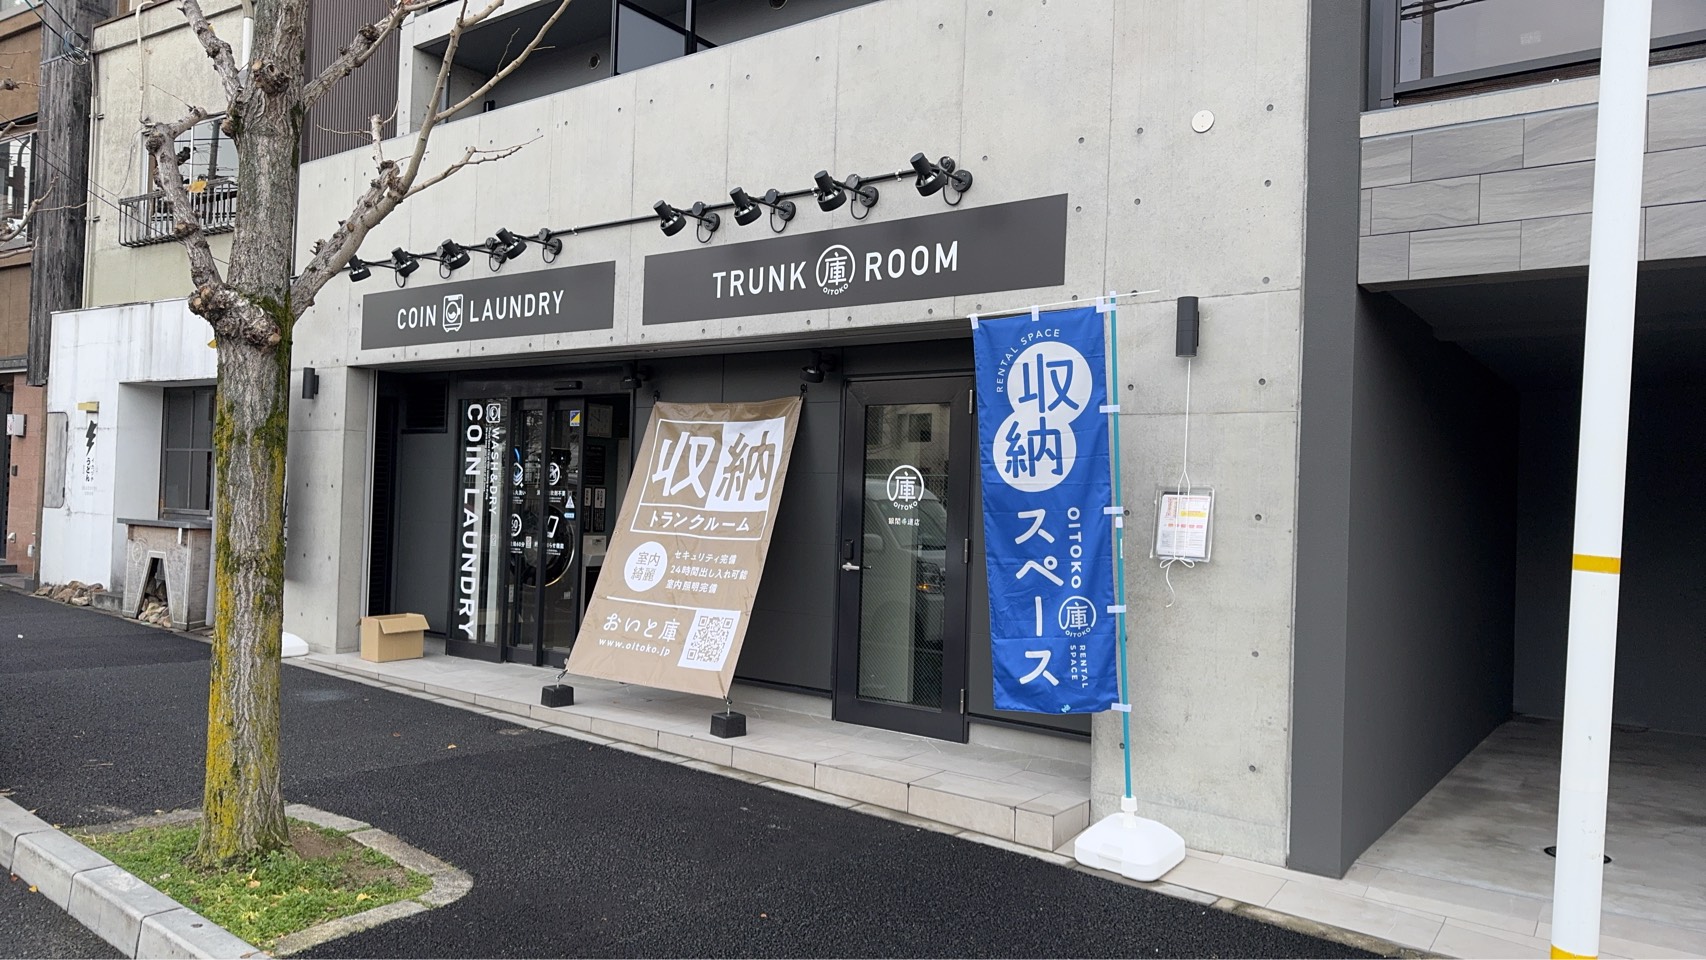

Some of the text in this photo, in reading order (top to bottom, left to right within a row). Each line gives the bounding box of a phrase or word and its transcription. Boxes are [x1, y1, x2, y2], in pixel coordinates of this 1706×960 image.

[713, 240, 959, 299] TRUNK ROOM
[824, 251, 848, 286] 庫
[822, 283, 849, 296] OITOKO
[396, 289, 565, 331] COIN LAUNDRY
[996, 328, 1061, 393] RENTAL SPACE
[1005, 353, 1080, 480] 収納
[652, 431, 776, 502] 収納
[893, 470, 917, 502] 庫
[458, 403, 483, 638] COIN LAUNDRY
[893, 501, 918, 511] OITOKO
[650, 511, 750, 533] トランクルーム
[636, 551, 661, 567] 室内
[674, 550, 737, 565] セキュリティ完備
[1067, 507, 1082, 589] OITOKO
[631, 566, 656, 582] 綺麗
[665, 578, 718, 594] 室内照明完備
[670, 565, 749, 580] 24時間出し入れ可能
[1015, 508, 1064, 686] スペース
[603, 612, 681, 642] おいと庫
[1065, 602, 1089, 630] 庫
[598, 638, 671, 657] www.oitoko.jp
[1065, 627, 1091, 638] OITOKO
[1069, 644, 1079, 681] SPACE
[1079, 644, 1089, 688] RENTAL
